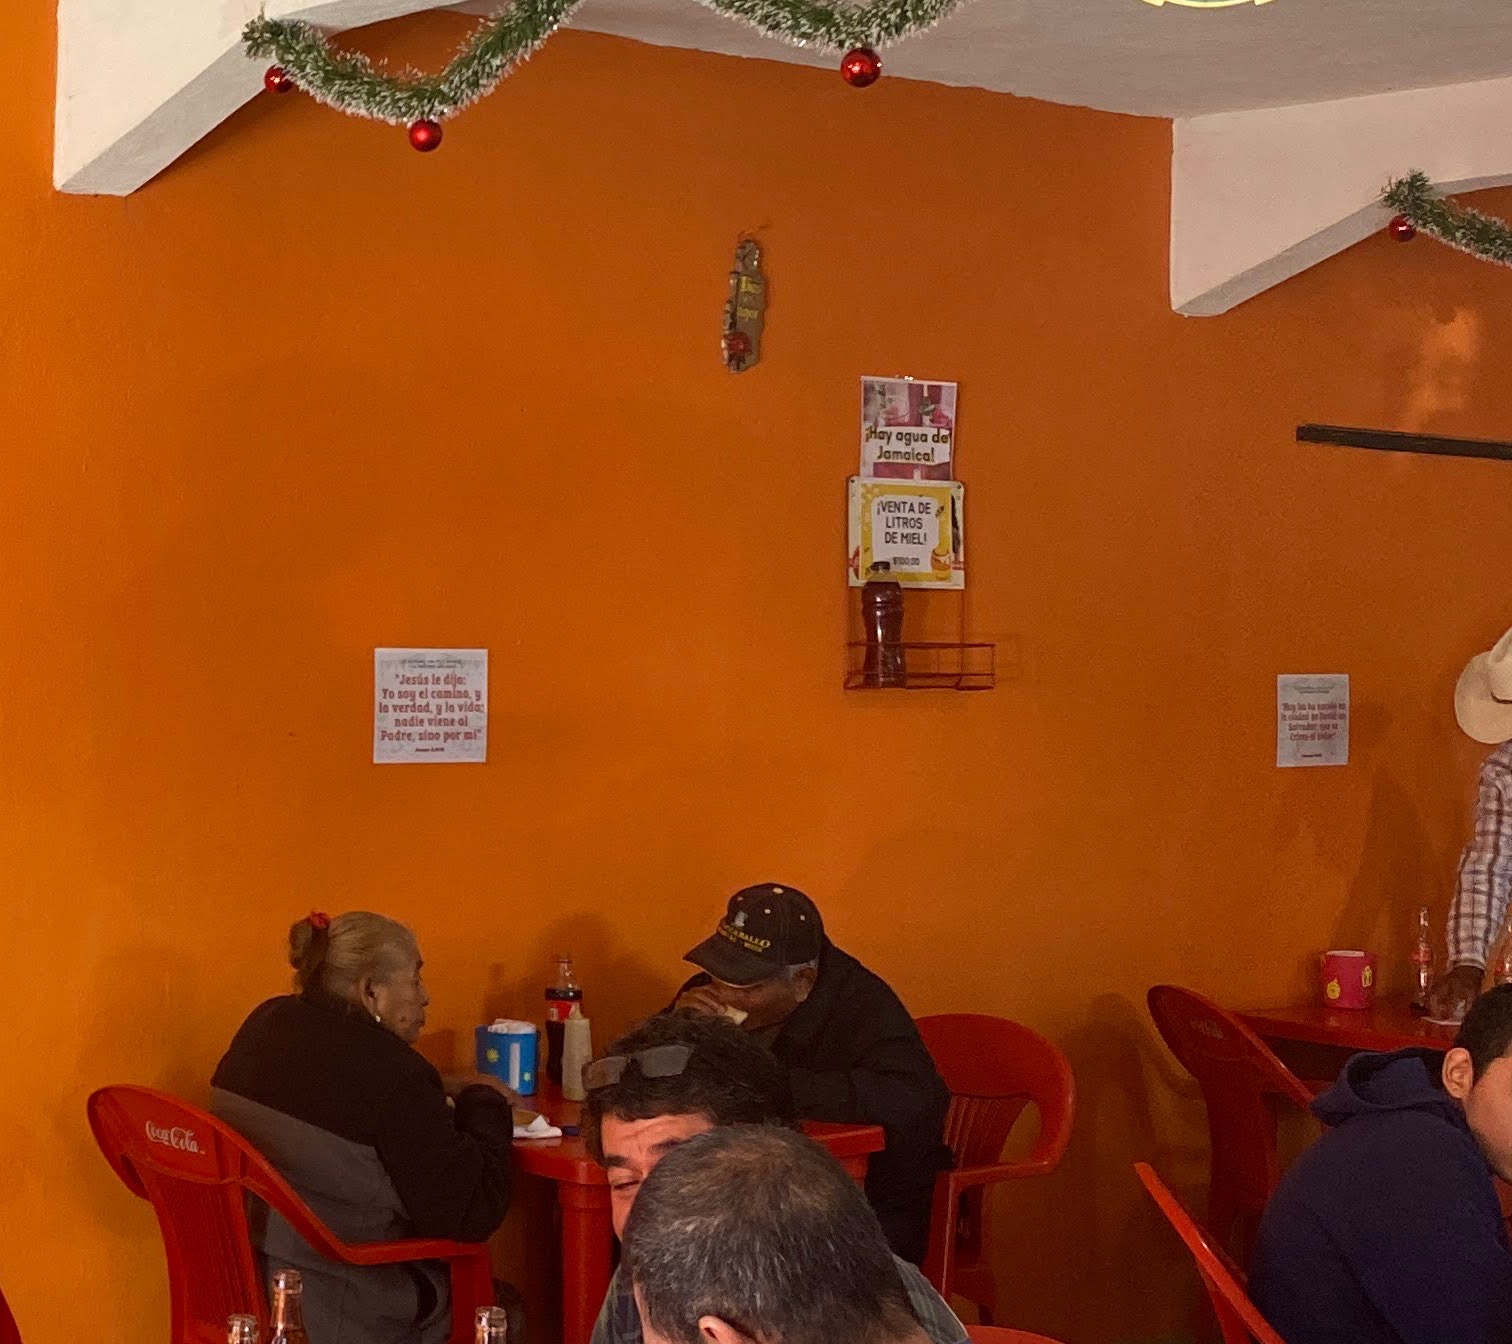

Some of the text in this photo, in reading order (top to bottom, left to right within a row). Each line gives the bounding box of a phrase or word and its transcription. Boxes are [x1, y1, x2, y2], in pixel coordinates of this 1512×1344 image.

[865, 425, 949, 446] ¡Hay agua de
[876, 446, 936, 463] Jamaica!
[876, 500, 932, 515] ¡VENTA DE
[885, 516, 923, 530] LITROS
[884, 531, 927, 546] DE MIEL!
[431, 673, 441, 685] le
[382, 688, 394, 699] Yo
[397, 690, 416, 702] soy
[419, 688, 429, 699] el
[475, 690, 482, 701] y
[378, 702, 389, 713] la
[436, 704, 442, 715] y
[445, 702, 455, 713] la
[394, 715, 468, 727] nadie viene al
[418, 731, 441, 741] sino
[443, 732, 460, 743] por
